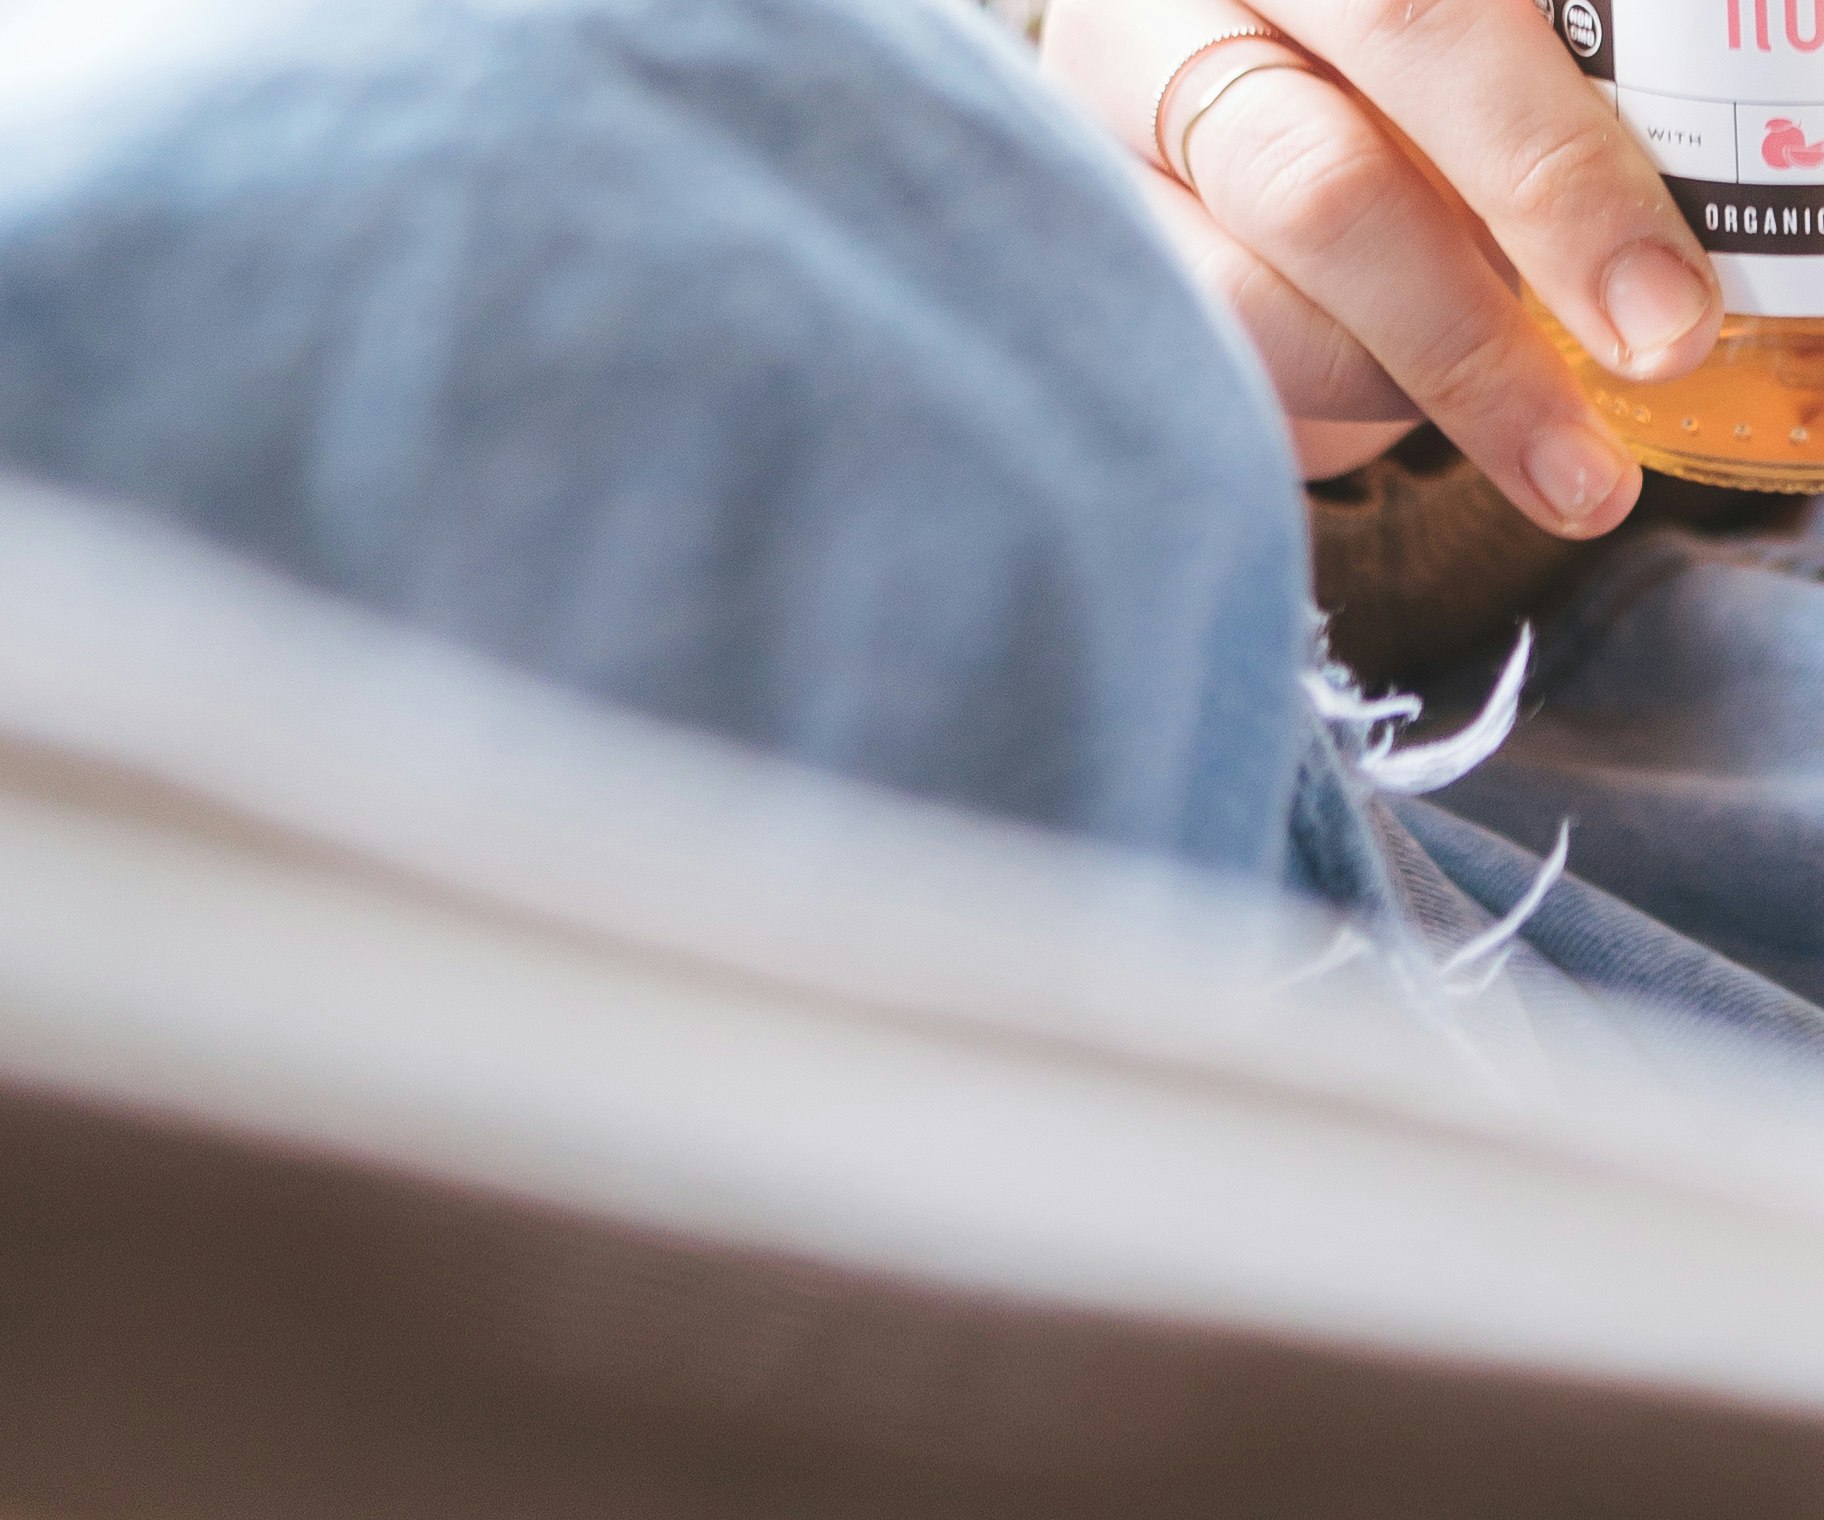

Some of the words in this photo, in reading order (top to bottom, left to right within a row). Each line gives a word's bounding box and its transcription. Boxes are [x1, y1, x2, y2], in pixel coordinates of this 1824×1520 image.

[1568, 7, 1593, 31] NON
[1569, 24, 1595, 48] GMO
[1647, 125, 1702, 147] WITH
